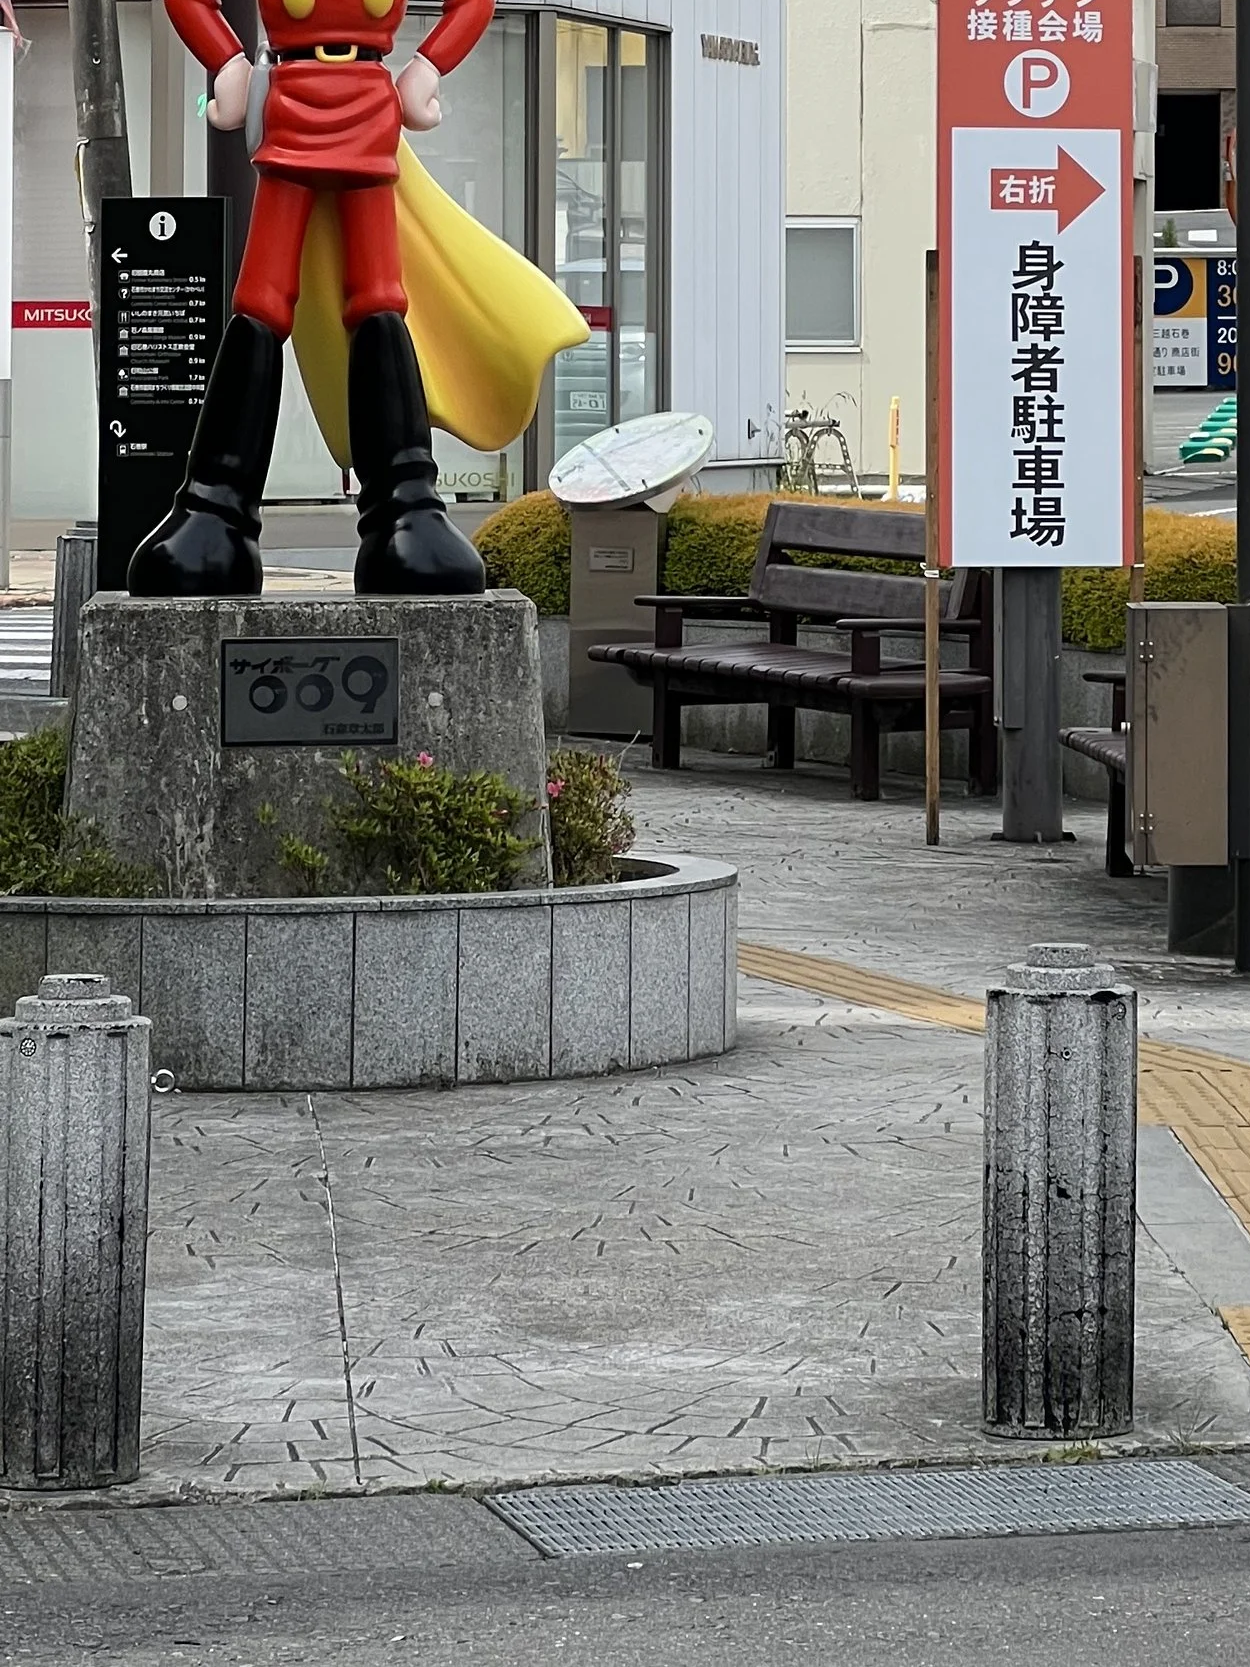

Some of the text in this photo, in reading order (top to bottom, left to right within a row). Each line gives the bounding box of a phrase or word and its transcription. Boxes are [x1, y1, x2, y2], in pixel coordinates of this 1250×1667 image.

[967, 8, 1104, 43] 接種会場
[1021, 56, 1059, 109] P
[998, 175, 1056, 204] 右折
[1010, 239, 1066, 548] 身障者駐車場
[229, 656, 341, 675] サイボーグ
[248, 655, 389, 715] 009
